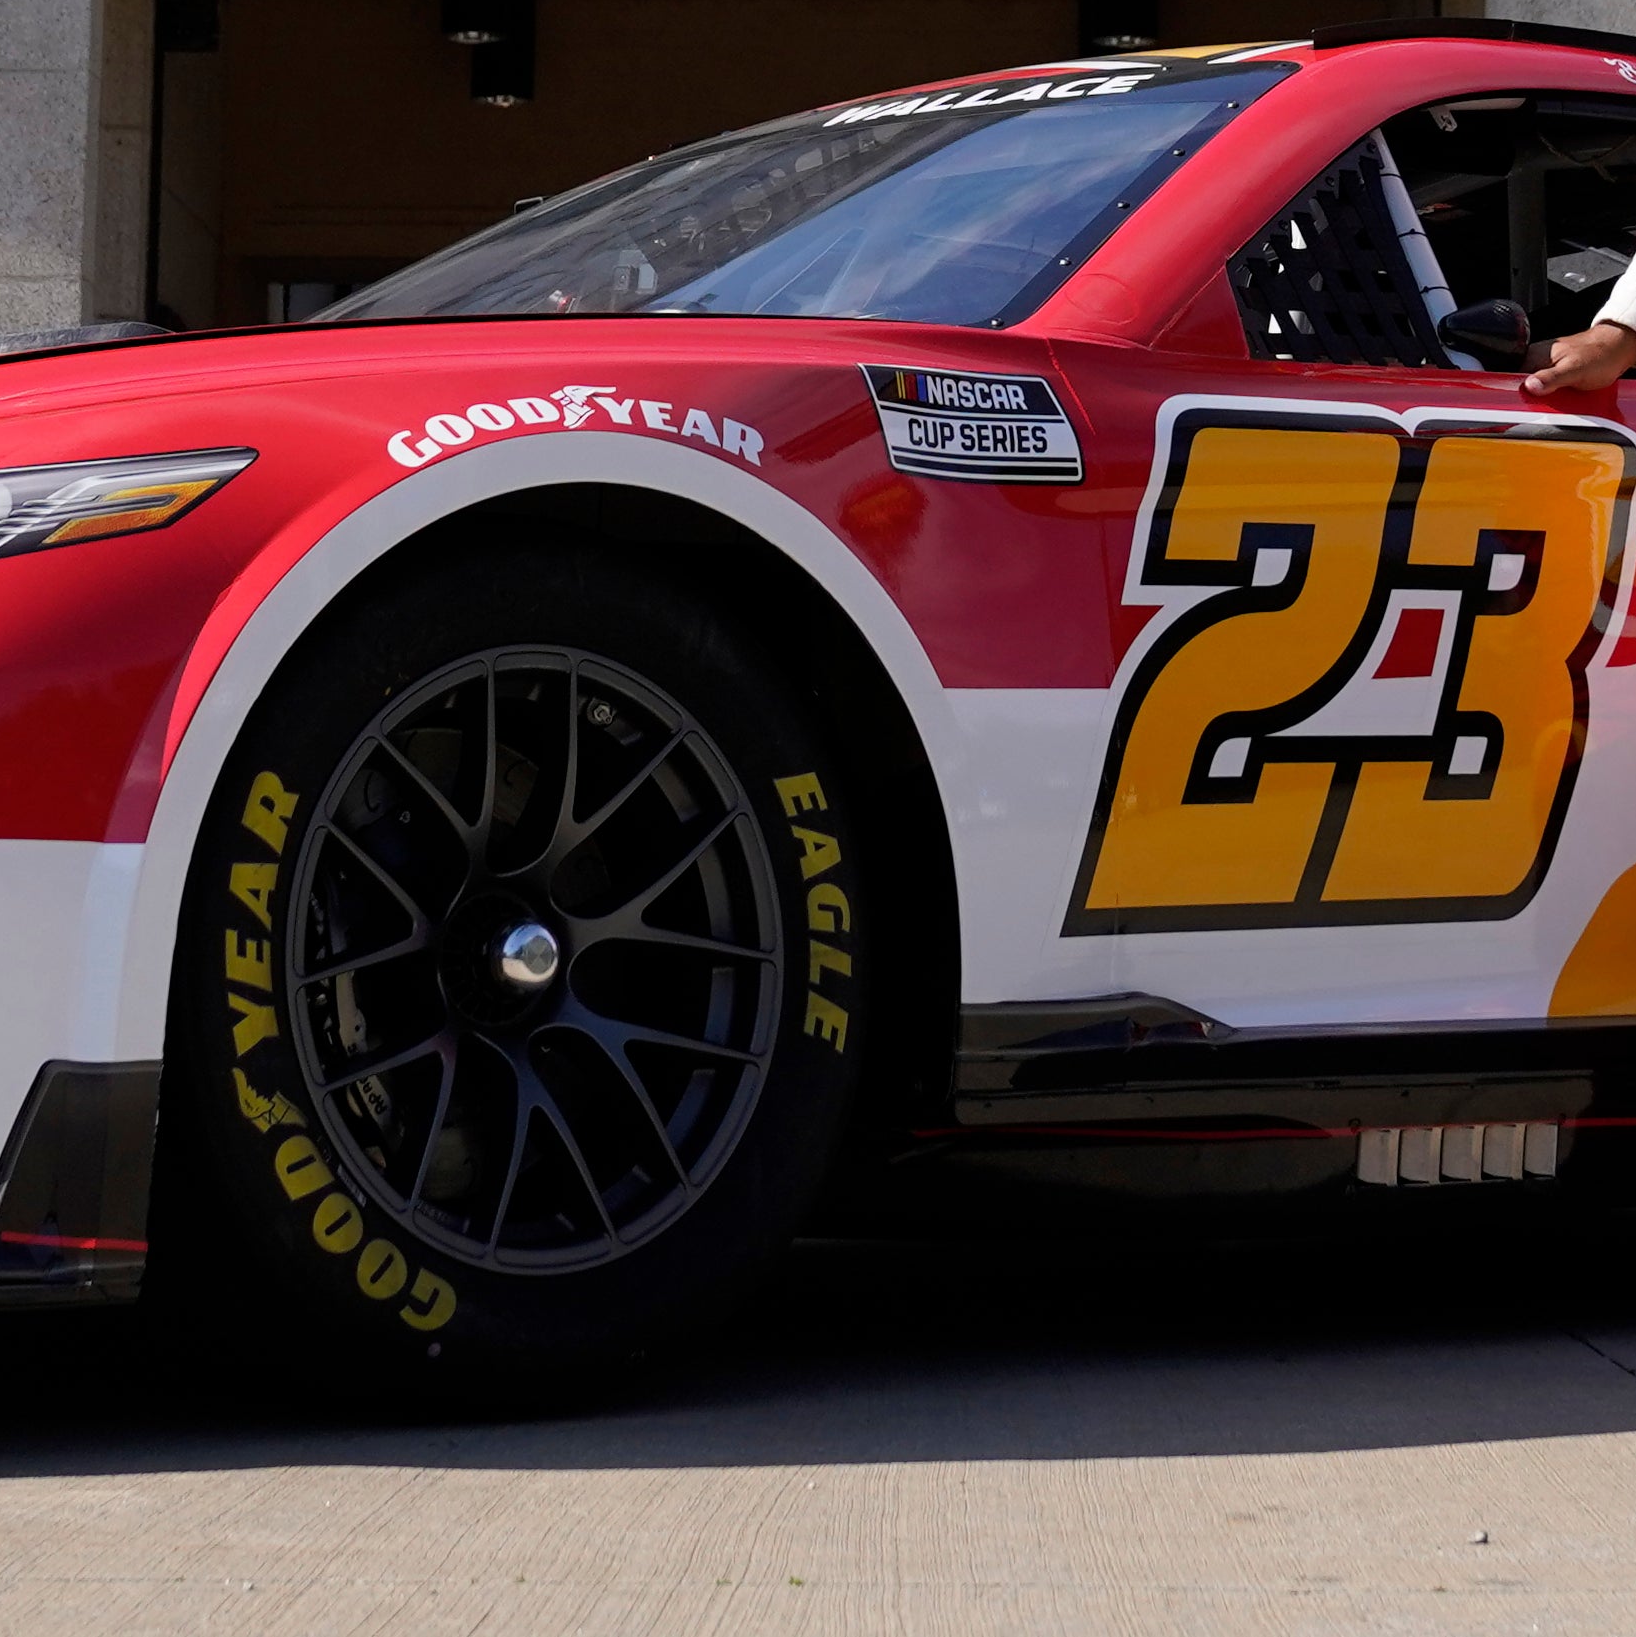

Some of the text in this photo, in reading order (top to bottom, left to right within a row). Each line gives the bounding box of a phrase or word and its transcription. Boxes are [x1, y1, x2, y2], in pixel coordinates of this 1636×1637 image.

[822, 73, 1156, 128] WALLACE
[387, 385, 765, 468] GOODYEAR
[926, 375, 1029, 411] NASCAR
[908, 417, 1048, 454] CUP SERIES
[773, 771, 853, 1054] EAGLE
[225, 770, 457, 1332] GOODYEAR
